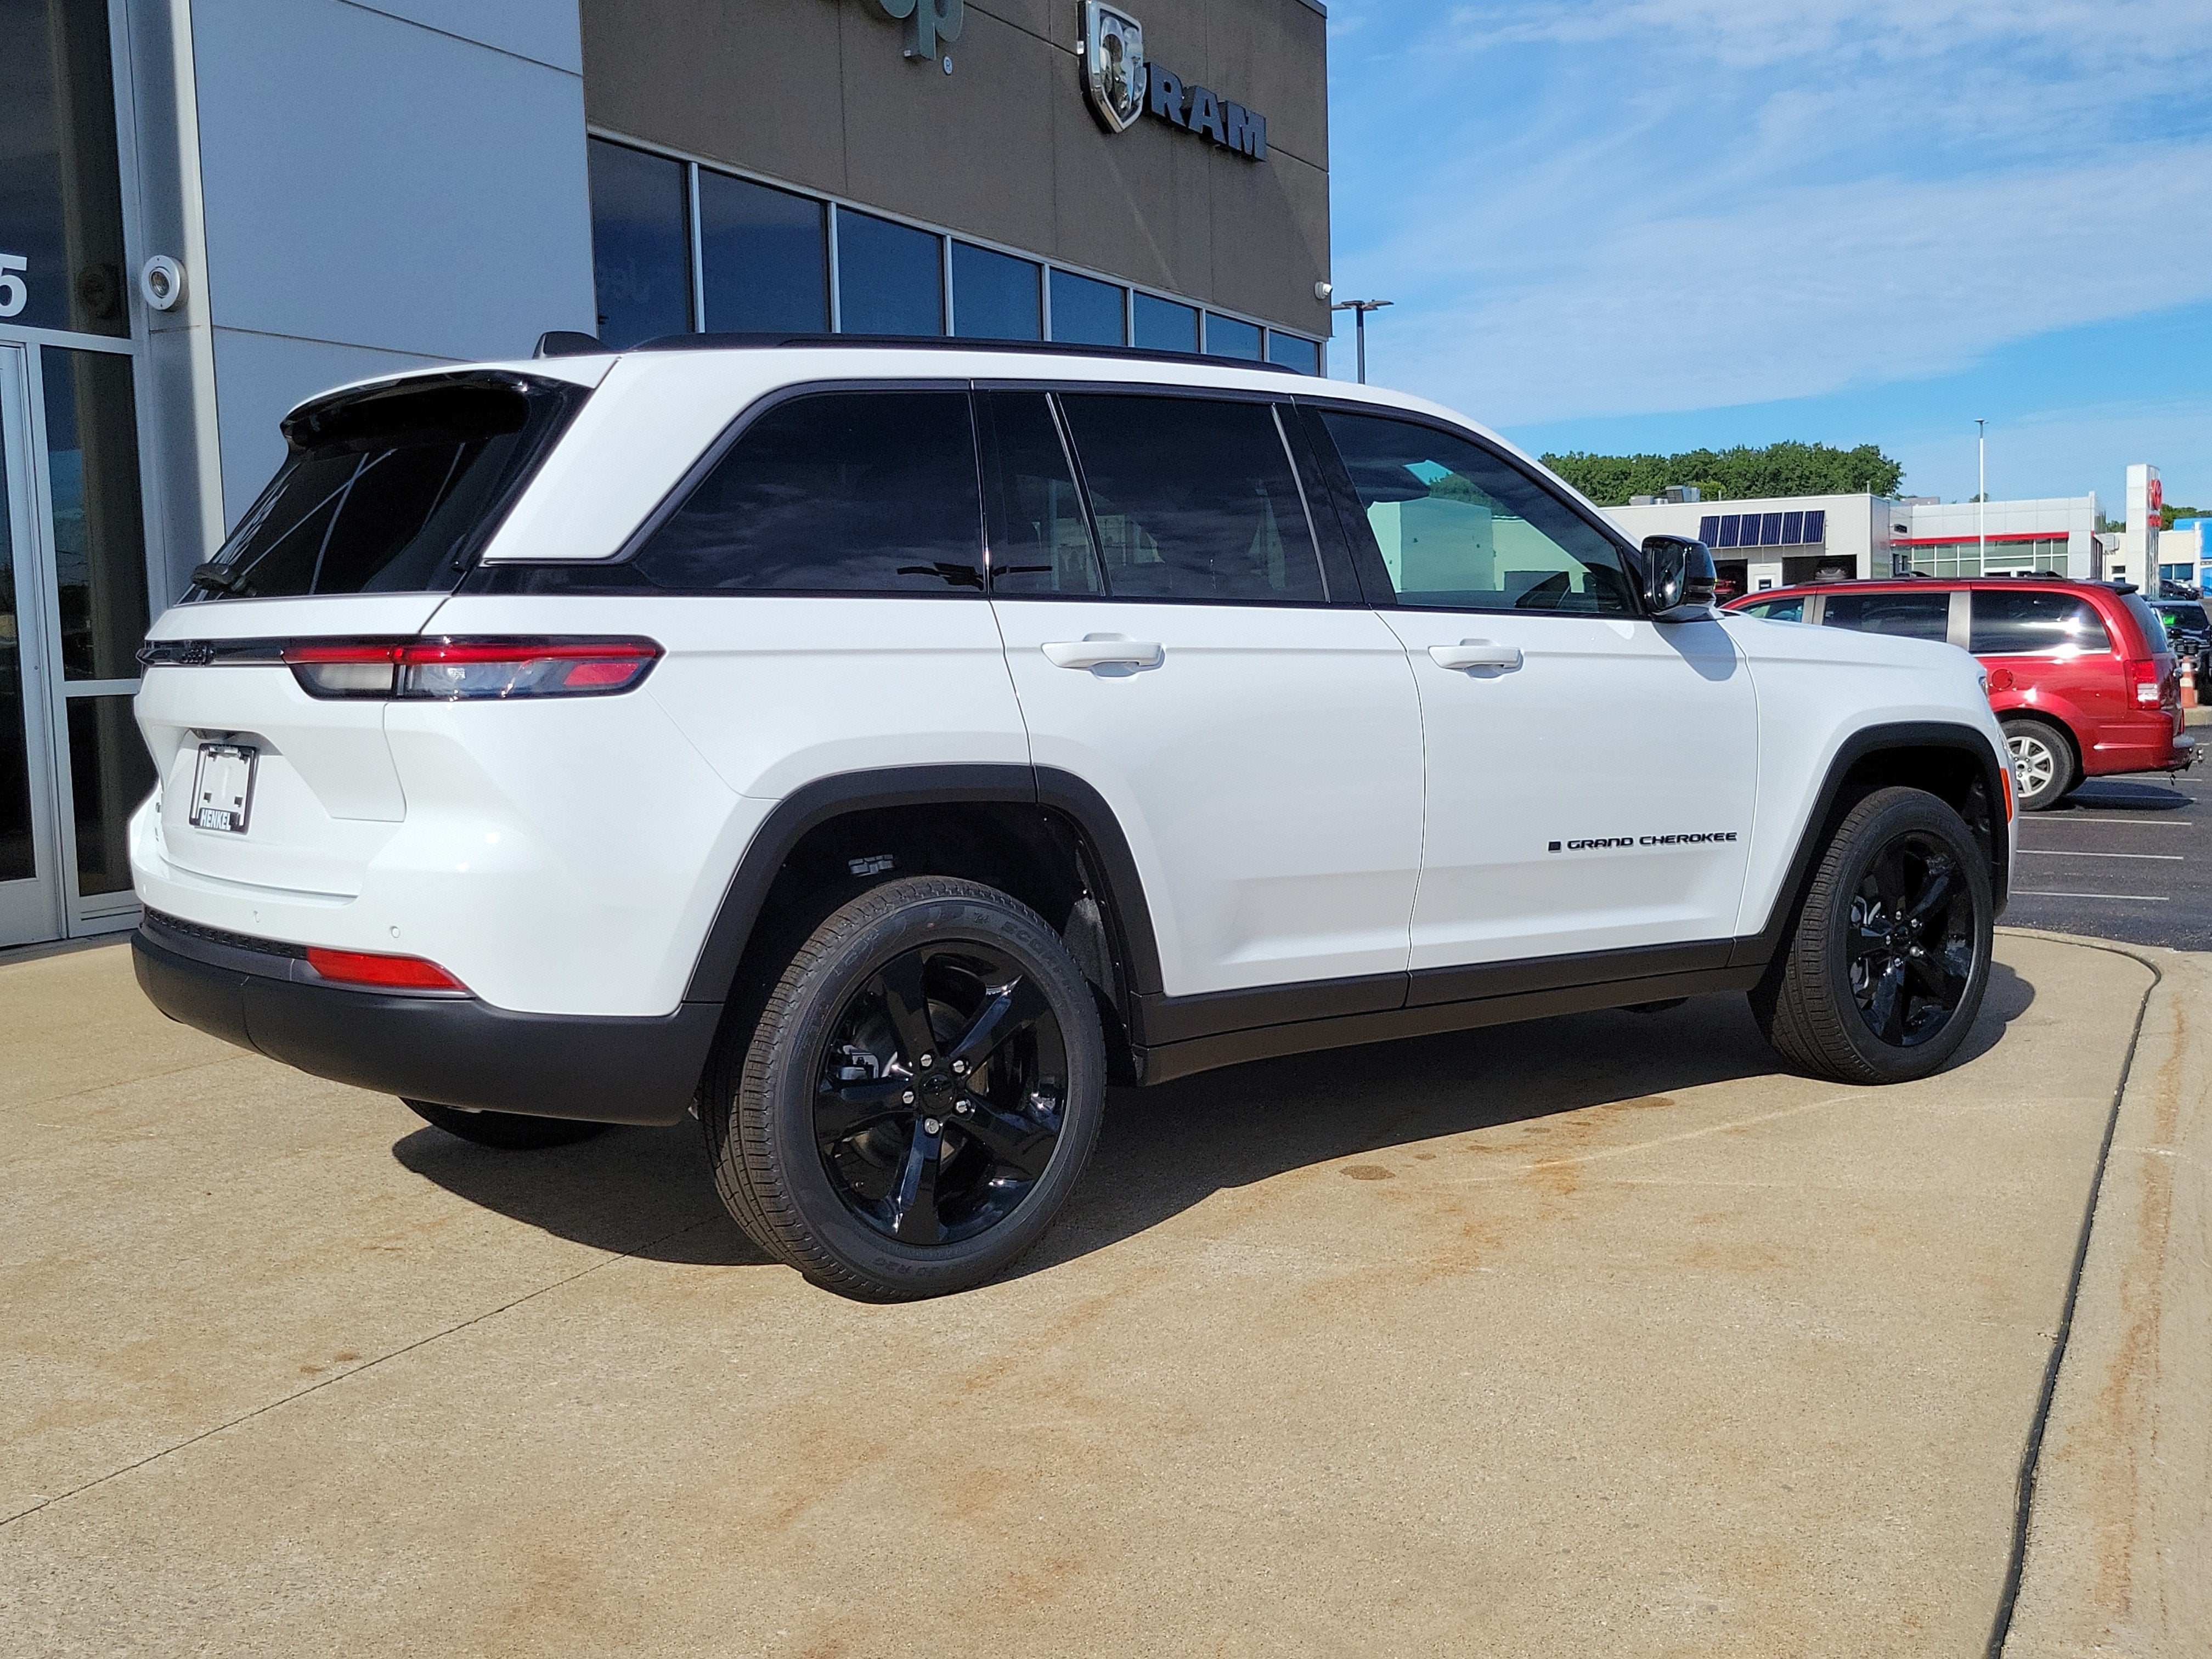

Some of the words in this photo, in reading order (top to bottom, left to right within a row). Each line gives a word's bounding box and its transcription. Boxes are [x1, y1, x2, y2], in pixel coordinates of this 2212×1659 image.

[1148, 61, 1267, 162] RAM
[200, 809, 231, 831] HENKEL
[1567, 837, 1634, 850] GRAND
[1639, 832, 1737, 845] CHEROKEE
